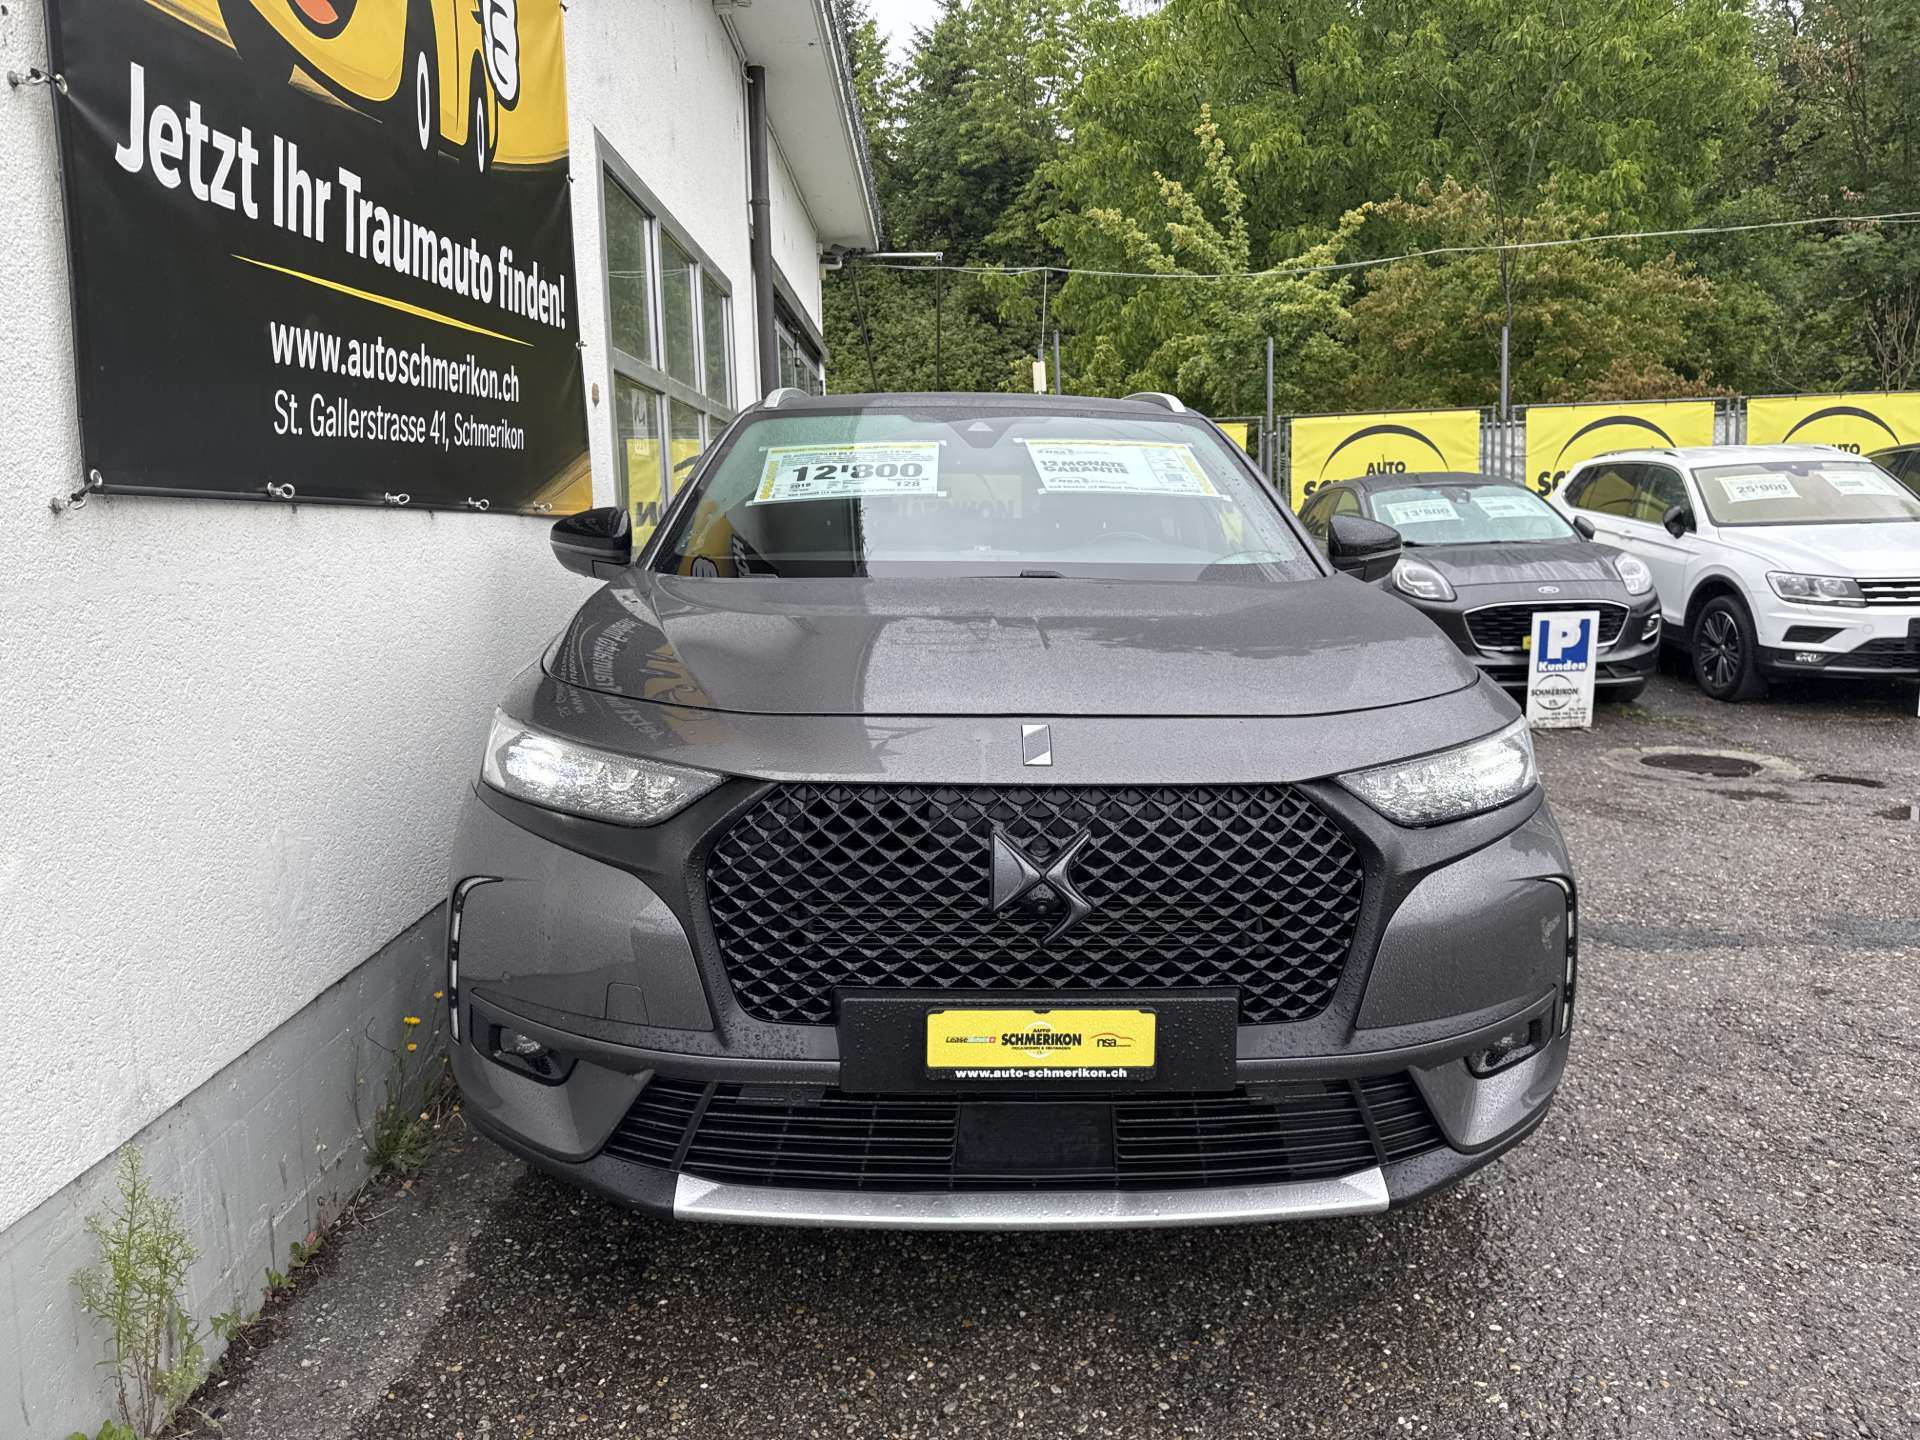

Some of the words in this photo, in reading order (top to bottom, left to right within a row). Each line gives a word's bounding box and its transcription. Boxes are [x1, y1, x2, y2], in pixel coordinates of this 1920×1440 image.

[115, 61, 259, 221] Jetzt
[272, 134, 333, 244] Ihr
[337, 166, 494, 304] Traumauto
[498, 245, 567, 331] finden!
[269, 320, 521, 404] www.autoschmerikon.ch
[272, 388, 304, 437] St.
[309, 392, 428, 446] Gallerstrasse
[429, 408, 452, 454] 41,
[453, 412, 526, 452] Schmerikon
[1828, 443, 1861, 456] UTO
[792, 462, 924, 482] 12'800
[1366, 461, 1407, 476] AUTO
[1538, 660, 1587, 672] Kunden
[1001, 1033, 1082, 1046] SCHMERIKON
[1096, 1038, 1117, 1048] nsa
[954, 1068, 1128, 1078] www.auto-schmerikon.ch
